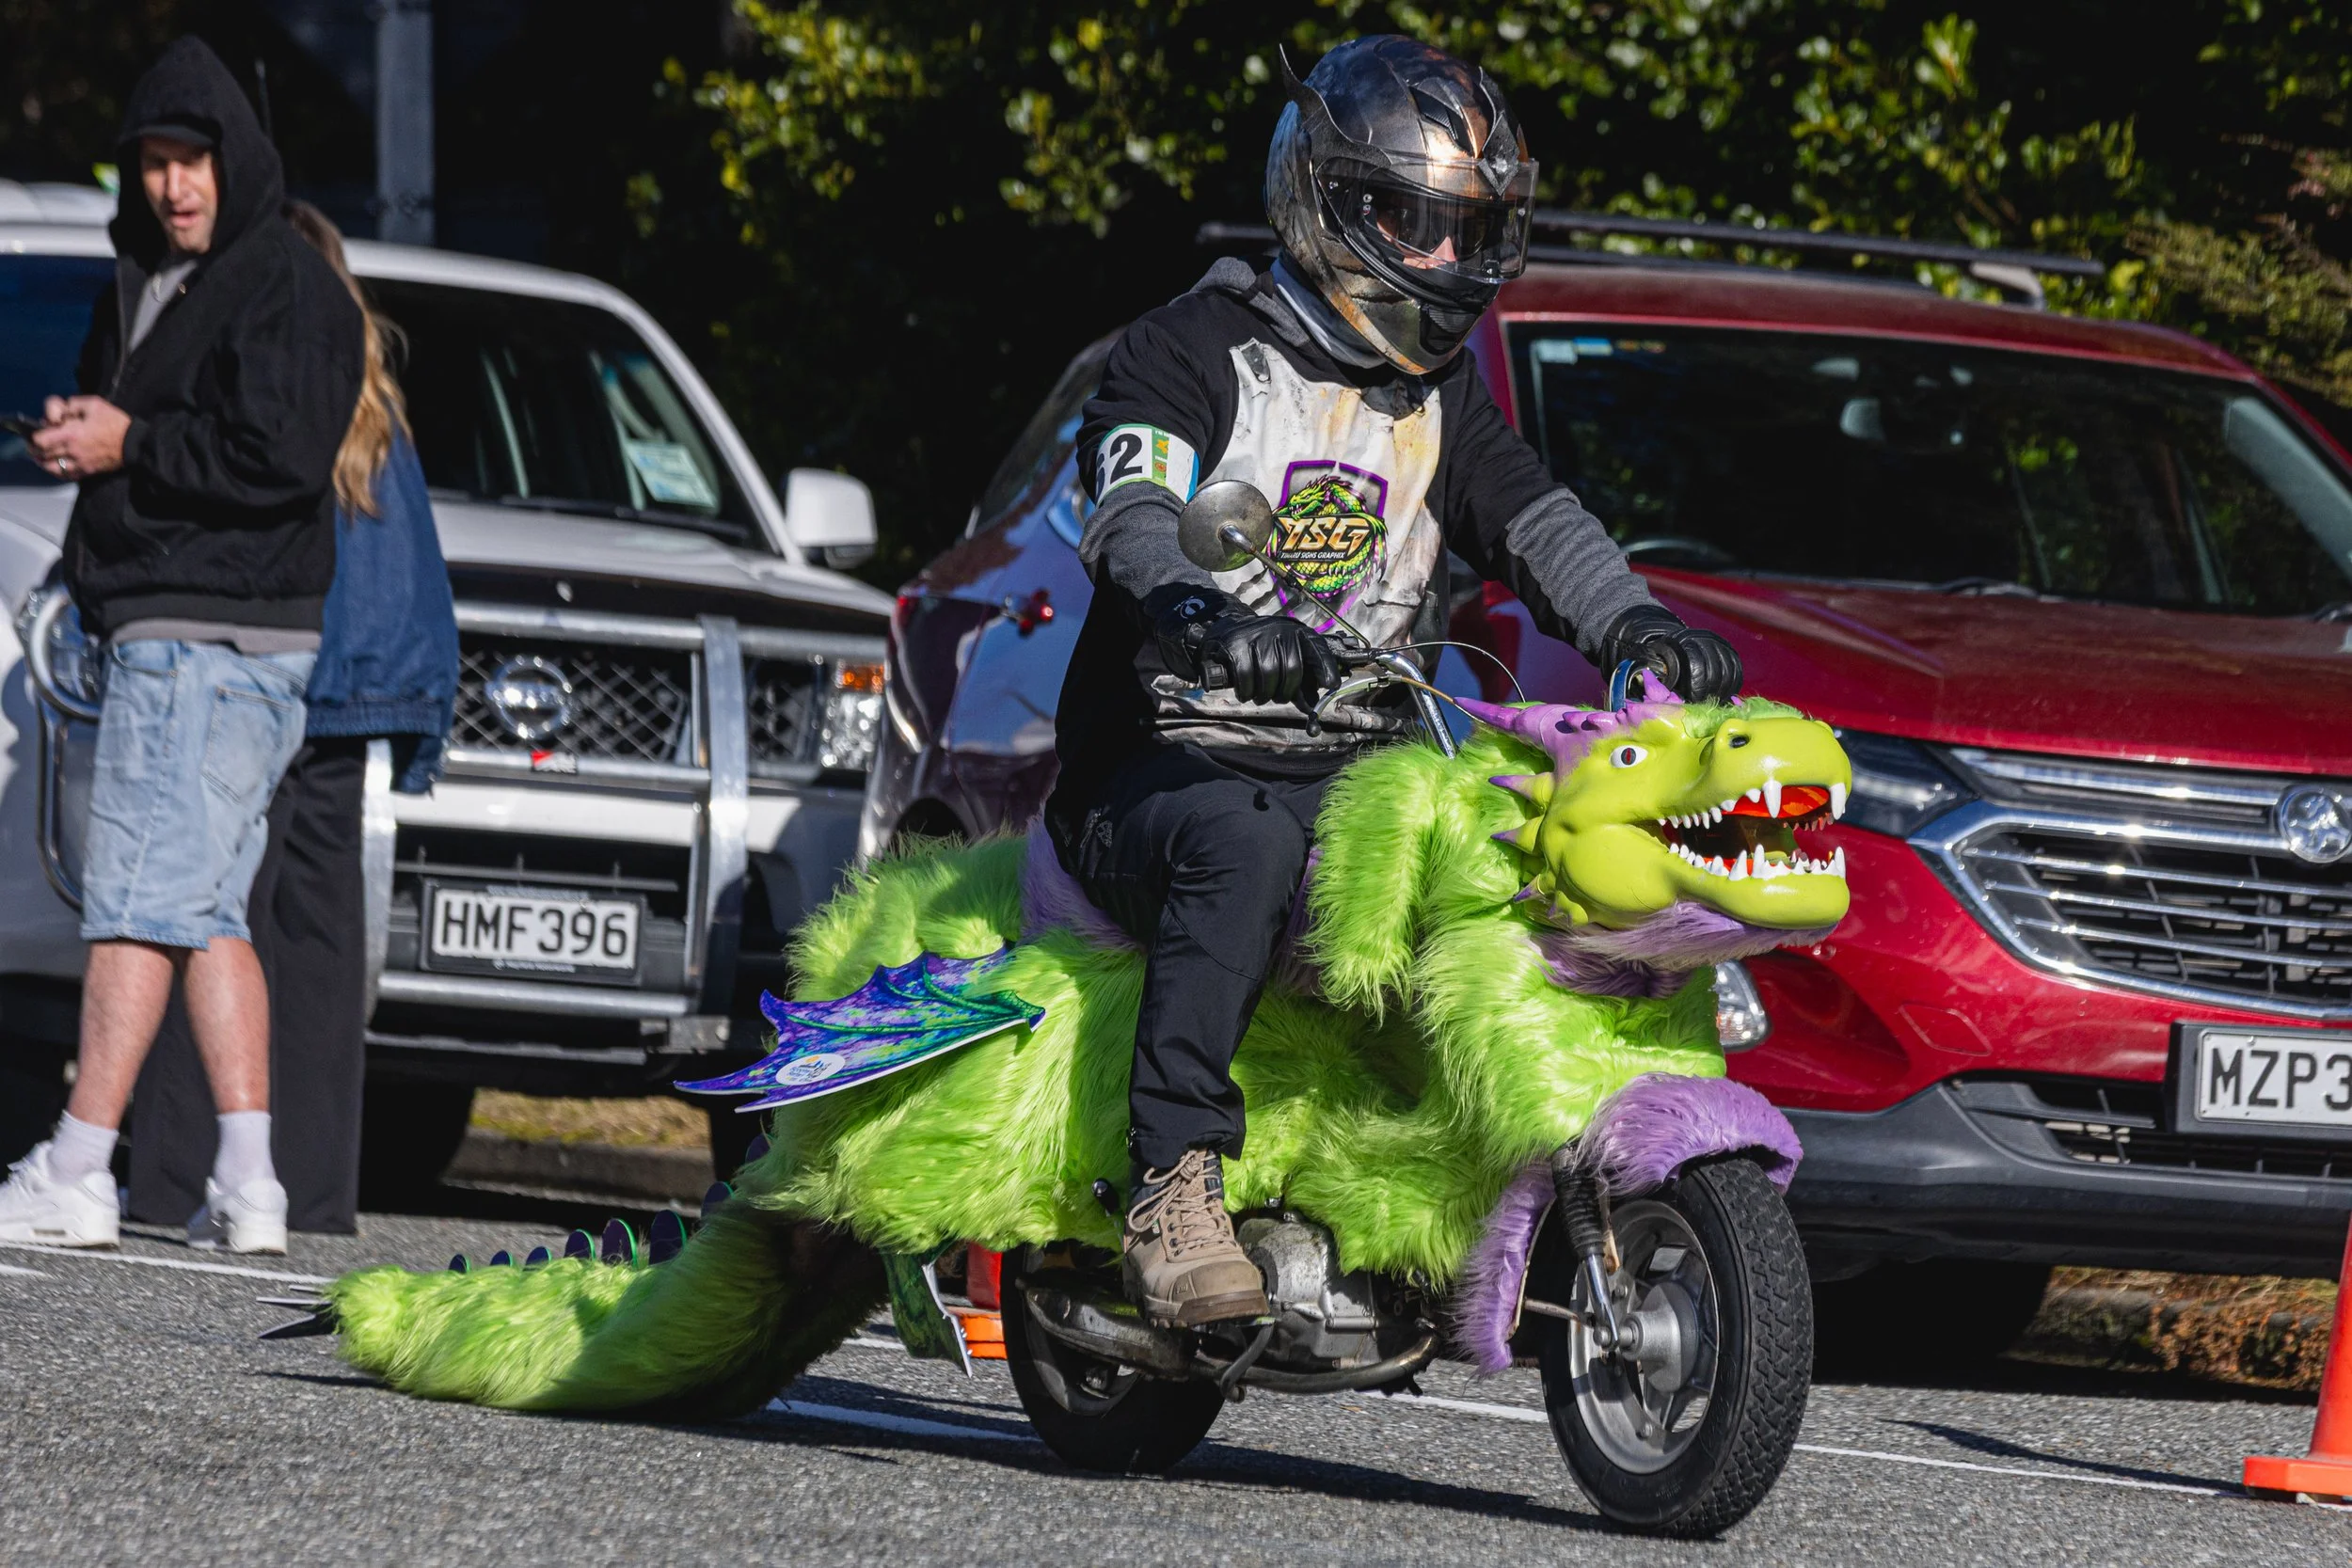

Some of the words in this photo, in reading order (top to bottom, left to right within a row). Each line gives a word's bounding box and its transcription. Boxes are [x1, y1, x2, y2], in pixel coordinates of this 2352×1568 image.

[1278, 516, 1371, 556] TSG
[1317, 550, 1345, 559] GRAPHIX
[441, 899, 628, 958] HMF396
[2209, 1048, 2352, 1111] MZP3
